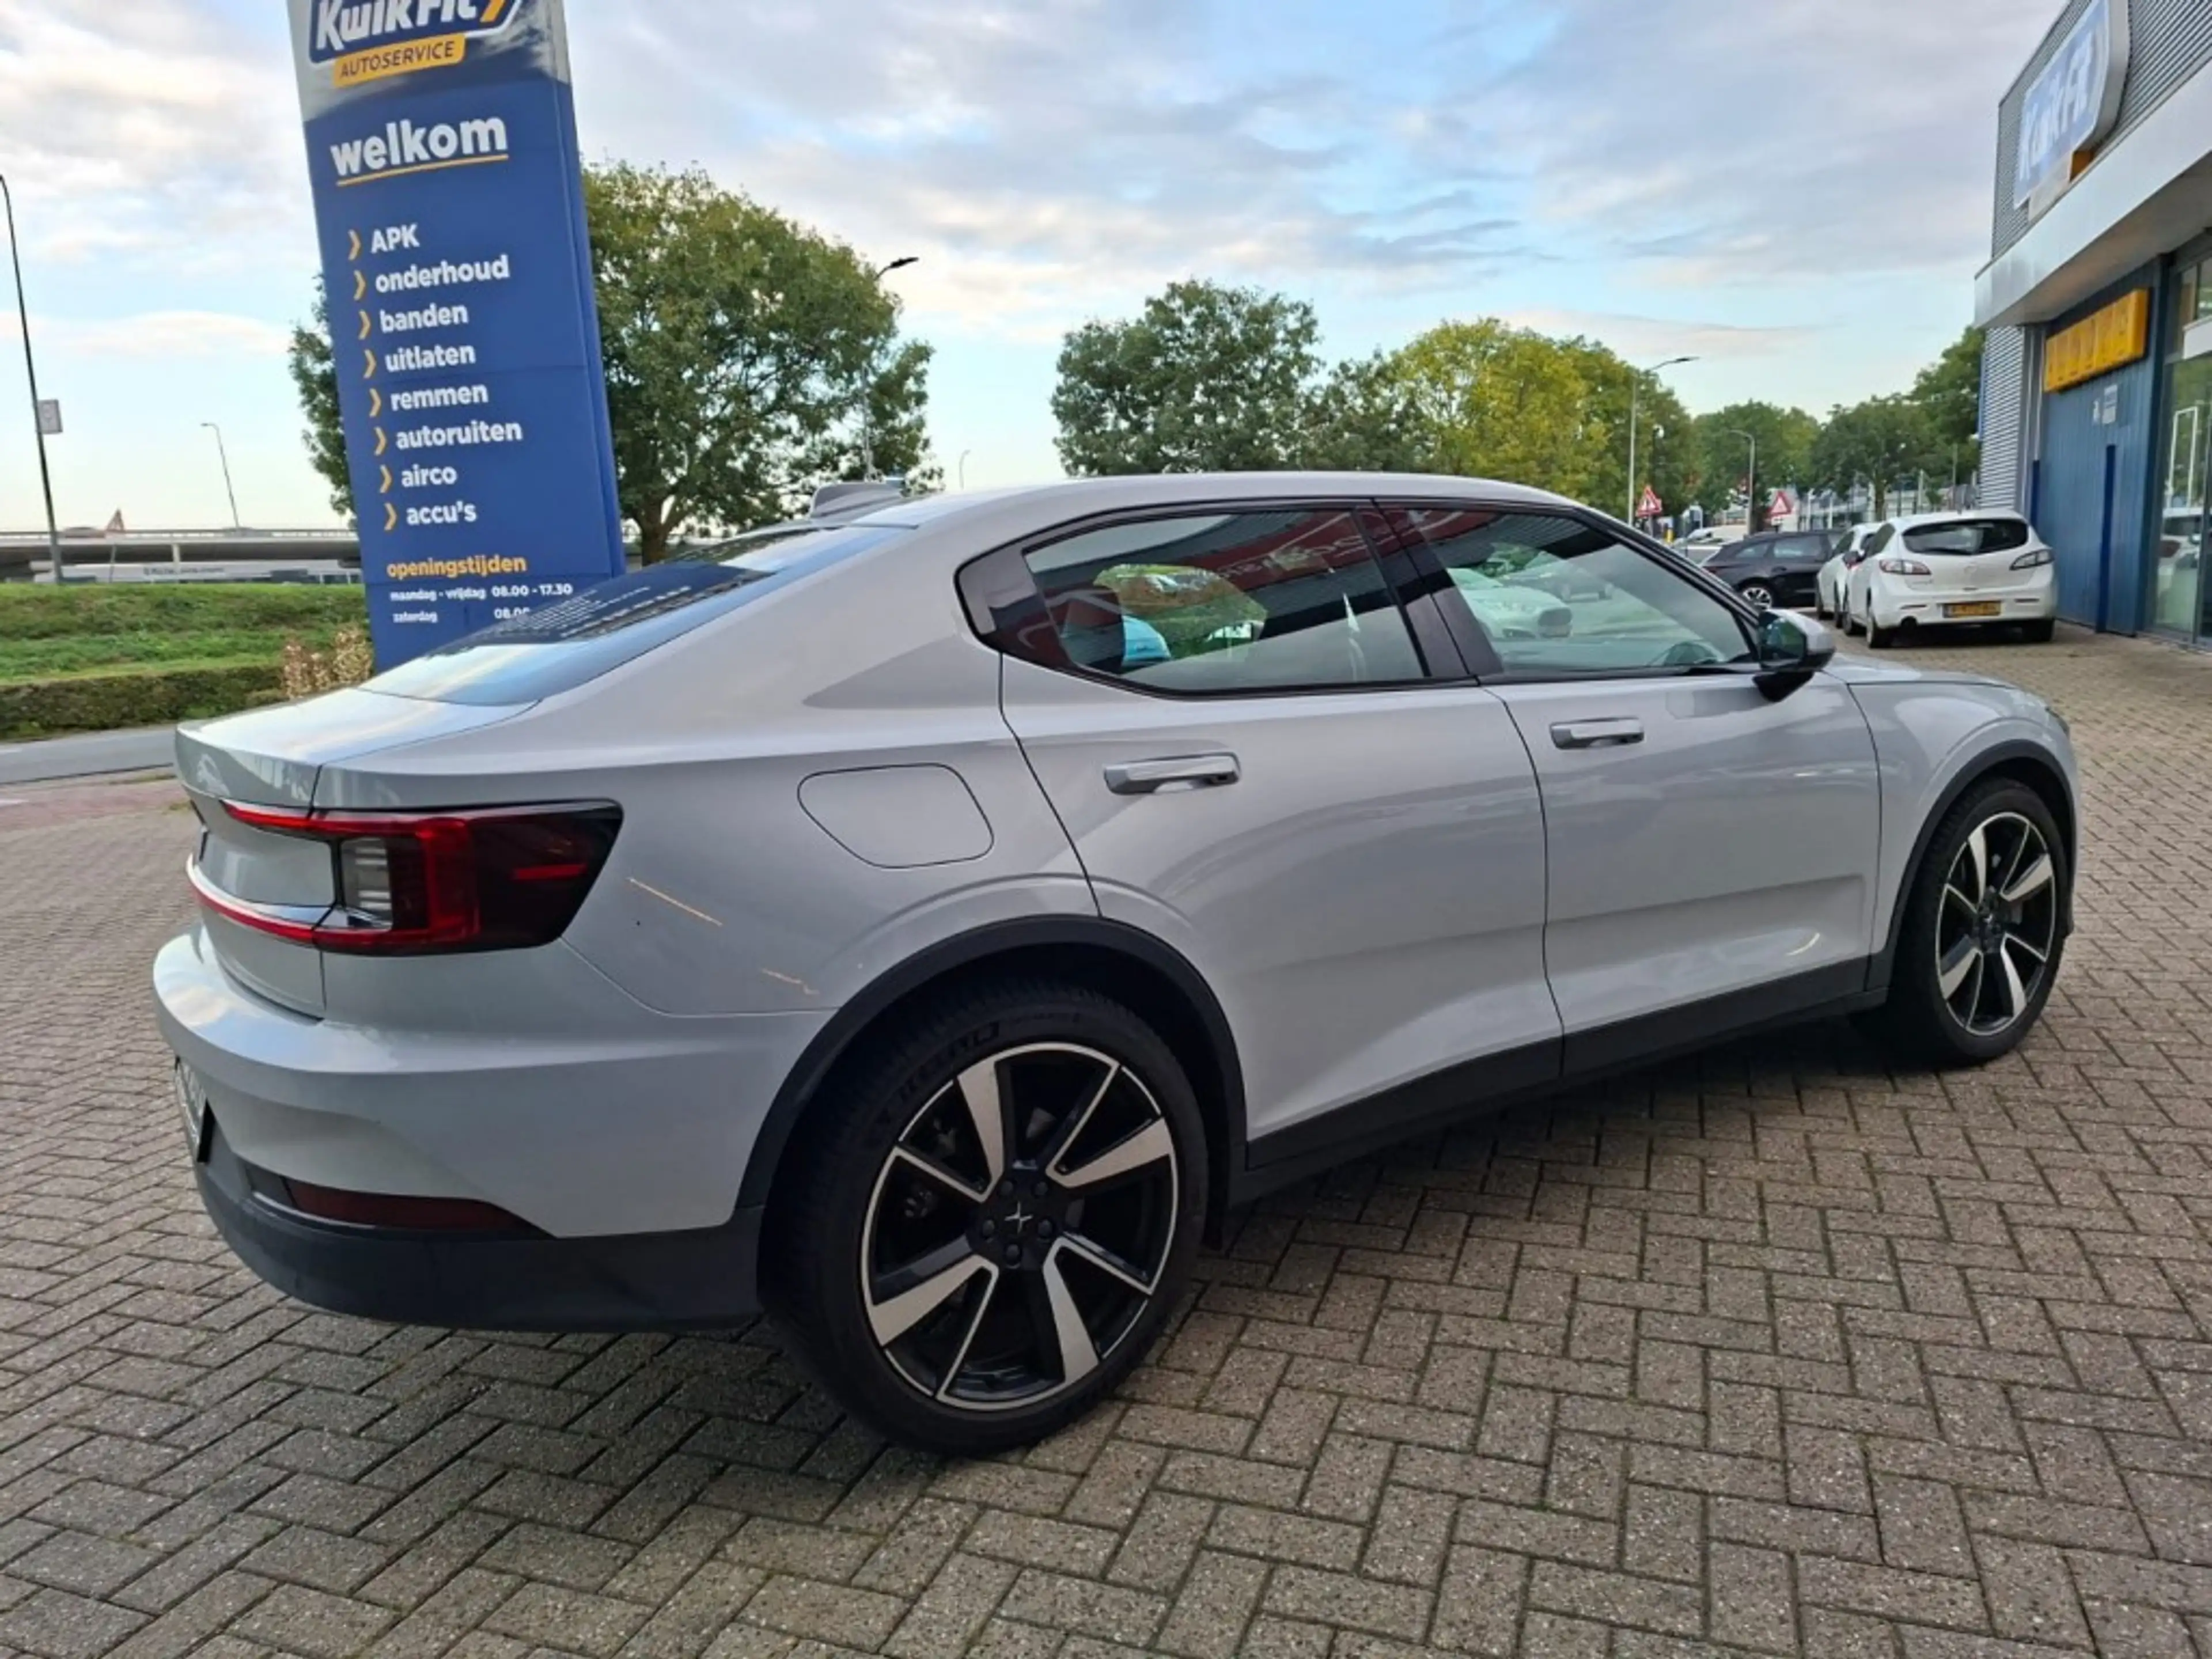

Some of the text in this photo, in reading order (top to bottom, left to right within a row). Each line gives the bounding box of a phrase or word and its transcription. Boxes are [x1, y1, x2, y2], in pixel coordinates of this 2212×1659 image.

[340, 41, 456, 78] AUTOSERVICE
[330, 118, 508, 175] welkom
[371, 224, 419, 253] APK
[375, 254, 510, 293] onderhoud
[380, 303, 468, 332] banden
[385, 344, 476, 372] uitlaten
[391, 384, 488, 411] remmen
[396, 421, 522, 449] autoruiten
[402, 464, 457, 487] airco
[406, 501, 476, 525] accu's
[387, 554, 527, 579] openingstijden
[445, 587, 486, 601] vrijdag
[491, 584, 529, 597] 08.00
[538, 582, 573, 596] 17.30
